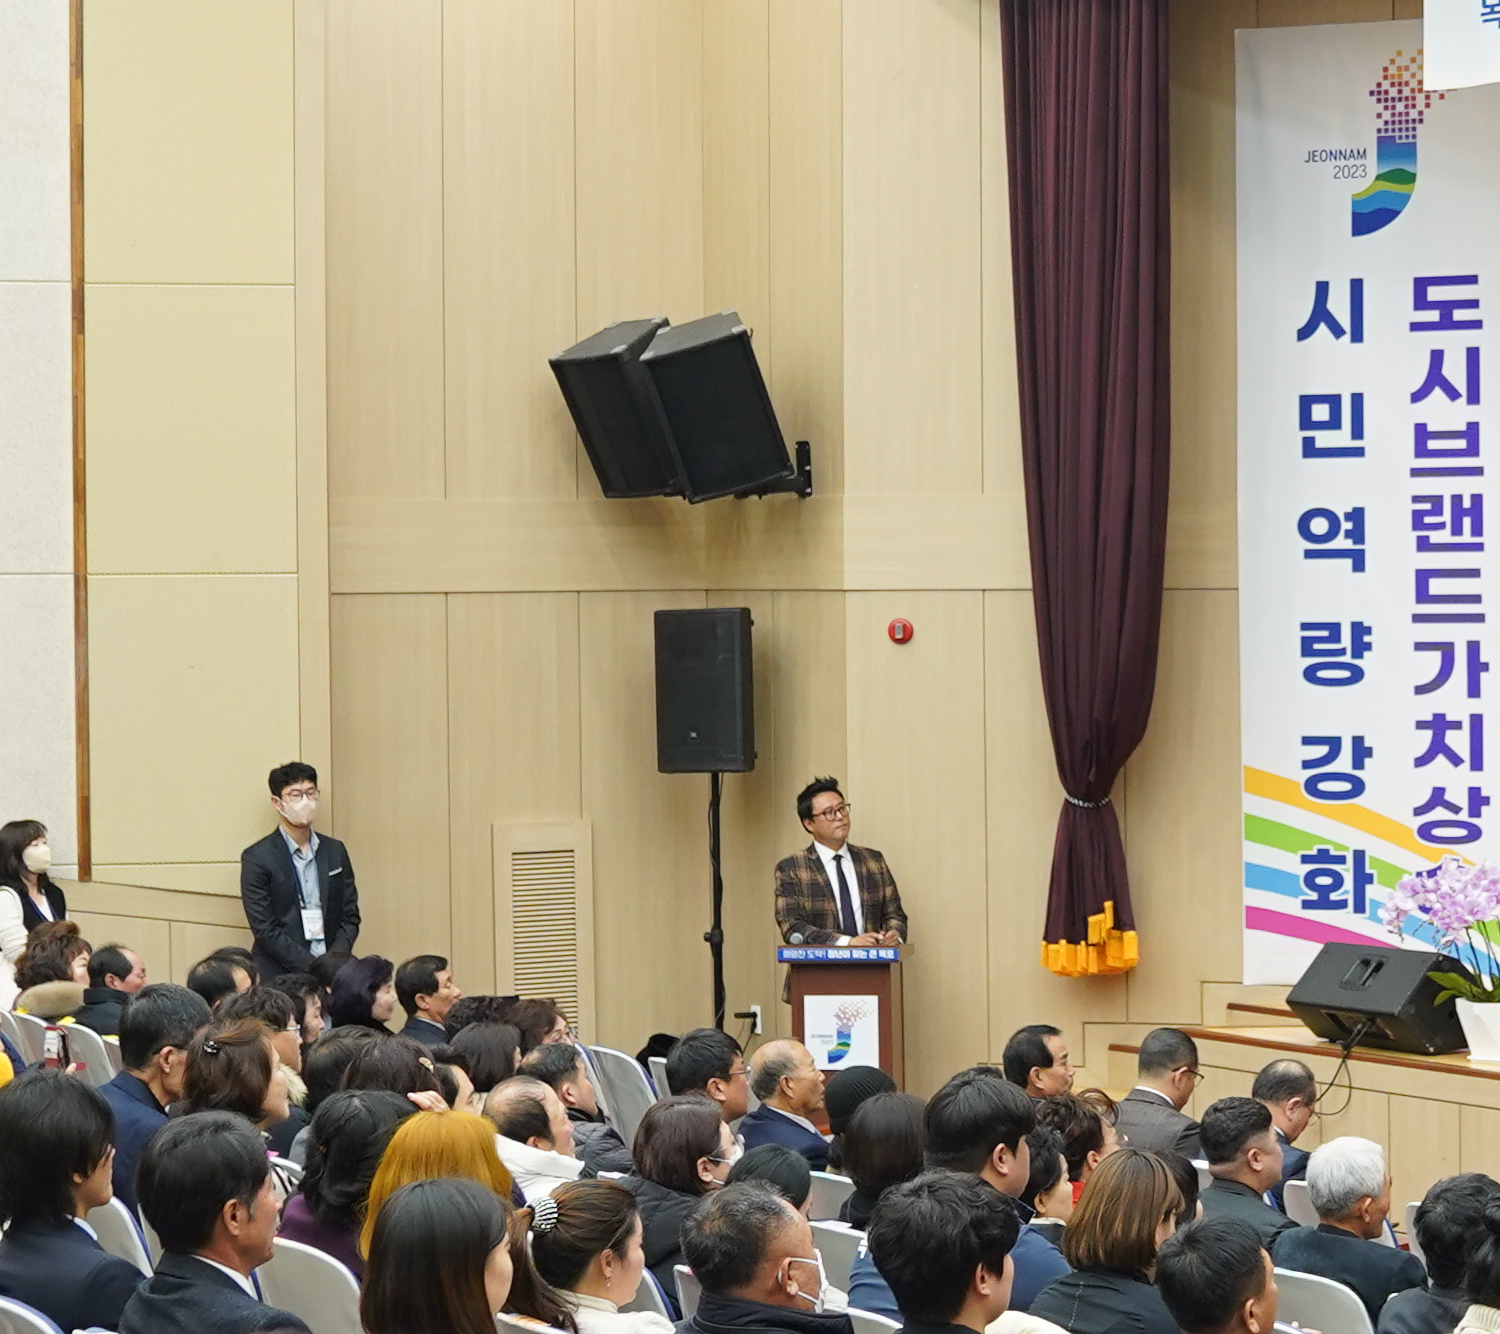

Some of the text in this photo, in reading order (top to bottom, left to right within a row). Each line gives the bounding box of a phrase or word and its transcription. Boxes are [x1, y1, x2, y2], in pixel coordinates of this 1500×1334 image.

[1304, 148, 1367, 163] JEONNAM
[1333, 163, 1367, 179] 2023
[1296, 278, 1374, 916] 시민역량강화
[1408, 273, 1490, 915] 도시브랜드가치상
